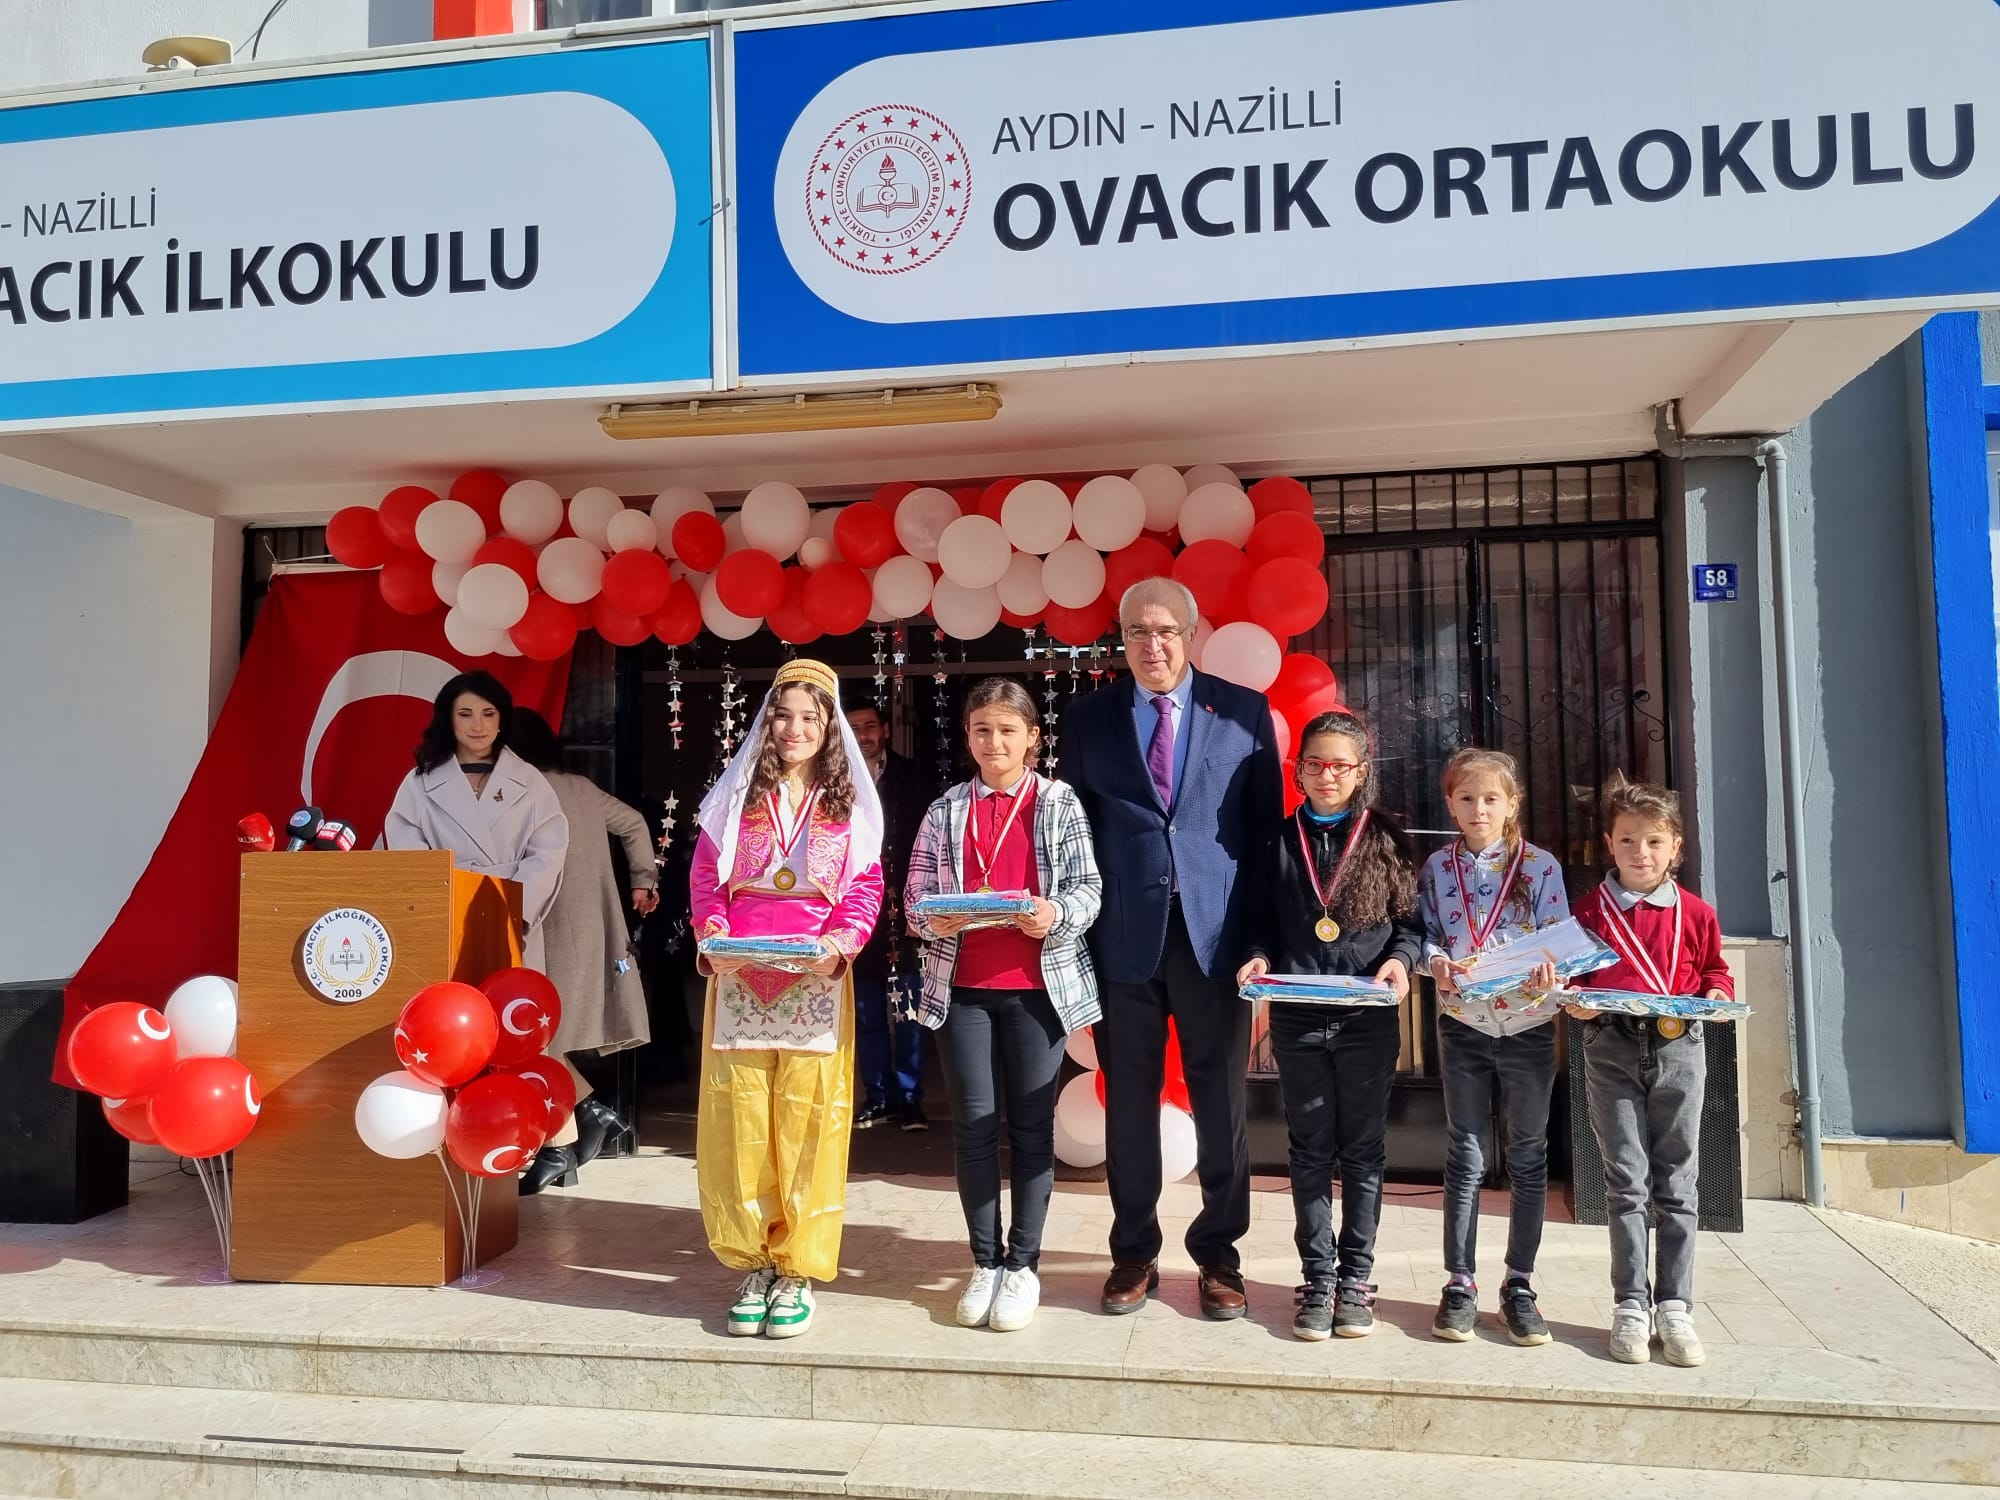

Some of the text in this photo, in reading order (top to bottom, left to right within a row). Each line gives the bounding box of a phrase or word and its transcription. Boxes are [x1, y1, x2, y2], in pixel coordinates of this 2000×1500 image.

[991, 107, 1125, 155] AYDIN
[1170, 79, 1342, 140] NAZİLLİ
[836, 134, 941, 242] TÜRKİYE CUMHURİYETİ MİLLİ EĞİTİM BAKANLIĞI
[993, 102, 1975, 252] OVACIK ORTAOKULU
[23, 187, 156, 238] NAZİLLİ
[165, 224, 540, 314] İLKOKULU
[1705, 569, 1728, 587] 58
[306, 923, 325, 965] OVACIK
[373, 946, 389, 987] OKULU
[334, 988, 362, 999] 2009
